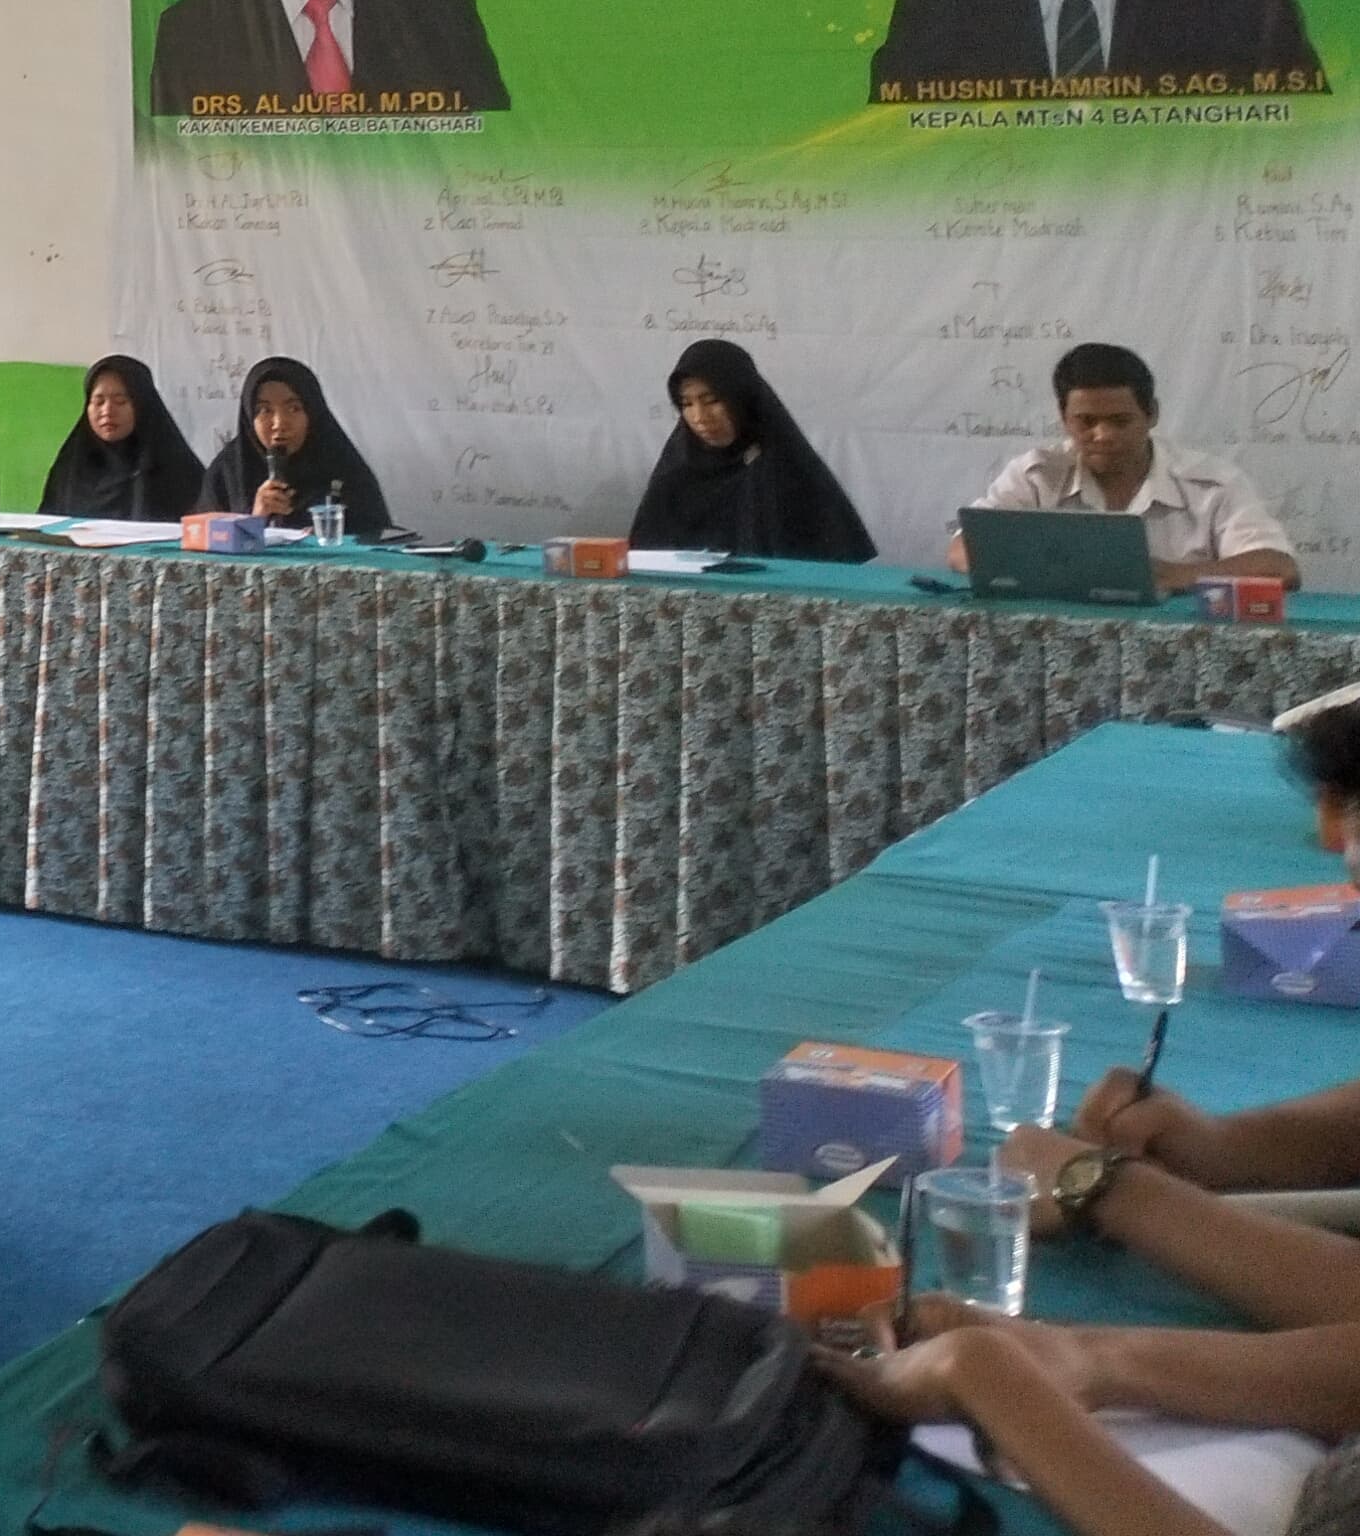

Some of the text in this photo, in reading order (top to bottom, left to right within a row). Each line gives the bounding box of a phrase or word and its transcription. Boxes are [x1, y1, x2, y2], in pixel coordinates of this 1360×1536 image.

[879, 83, 909, 102] M.
[917, 80, 1004, 101] HUSNI
[1011, 77, 1150, 100] THAMRIN,
[192, 92, 469, 115] DRS. AL JUFRI. M.PD.I.
[178, 119, 235, 135] KAKAN
[239, 118, 321, 134] KEMENAG
[909, 104, 1291, 129] KEPALA MTsN 4 BATANGHARI
